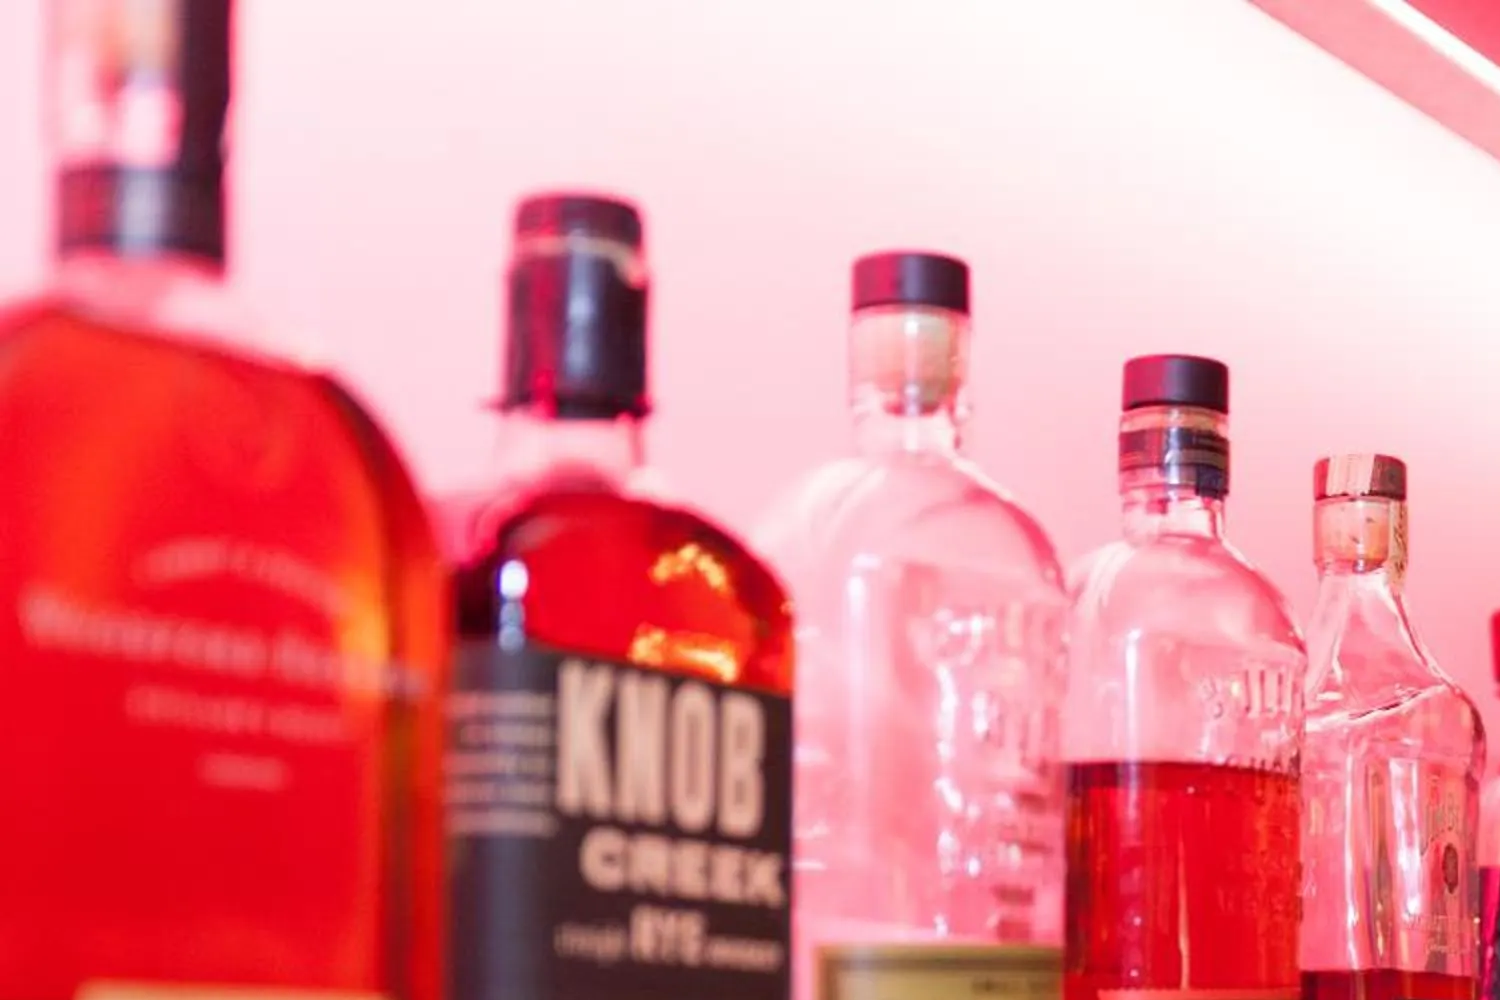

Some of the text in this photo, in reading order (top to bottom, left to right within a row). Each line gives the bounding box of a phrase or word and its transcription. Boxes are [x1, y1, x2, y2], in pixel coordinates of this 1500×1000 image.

[557, 658, 764, 838] KNOB
[580, 825, 784, 908] CREEK
[630, 905, 705, 966] RYE
